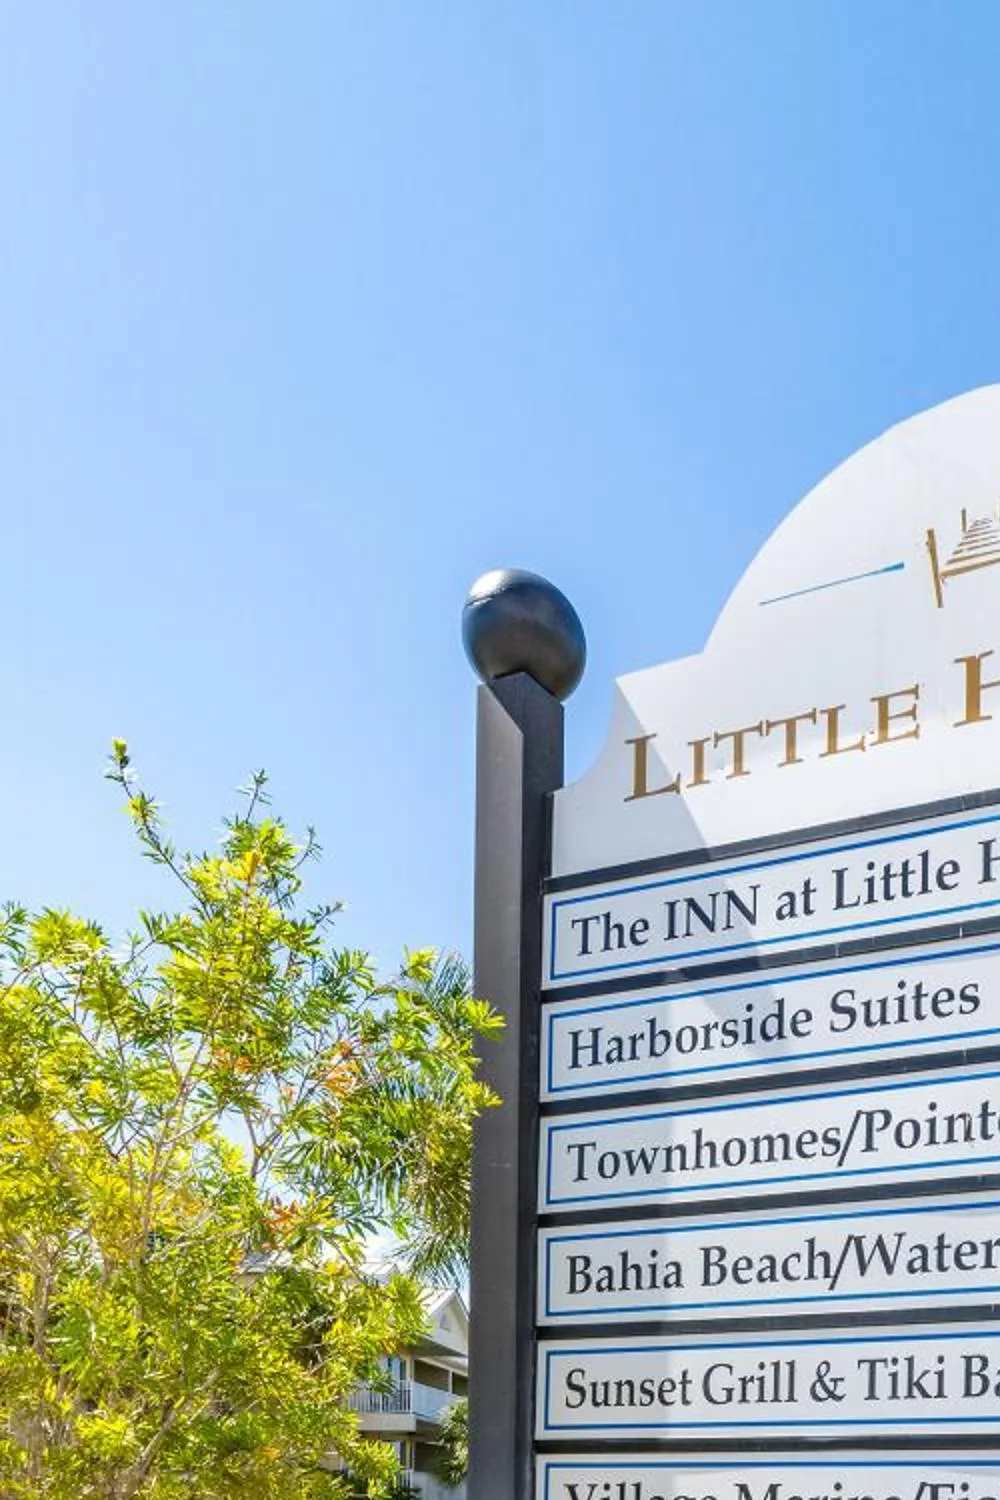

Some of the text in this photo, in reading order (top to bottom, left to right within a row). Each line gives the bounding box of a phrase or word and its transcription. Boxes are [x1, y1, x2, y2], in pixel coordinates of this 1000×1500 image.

[624, 683, 921, 802] LITTLE
[571, 911, 649, 957] The
[664, 885, 761, 941] INN
[776, 876, 816, 921] at
[831, 849, 960, 911] Little
[567, 981, 981, 1069] Harborside Suites
[566, 1250, 684, 1295] Bahia
[564, 1367, 692, 1410] Sunset
[703, 1360, 799, 1405] Grill
[809, 1360, 846, 1402] &
[858, 1355, 948, 1402] Tiki
